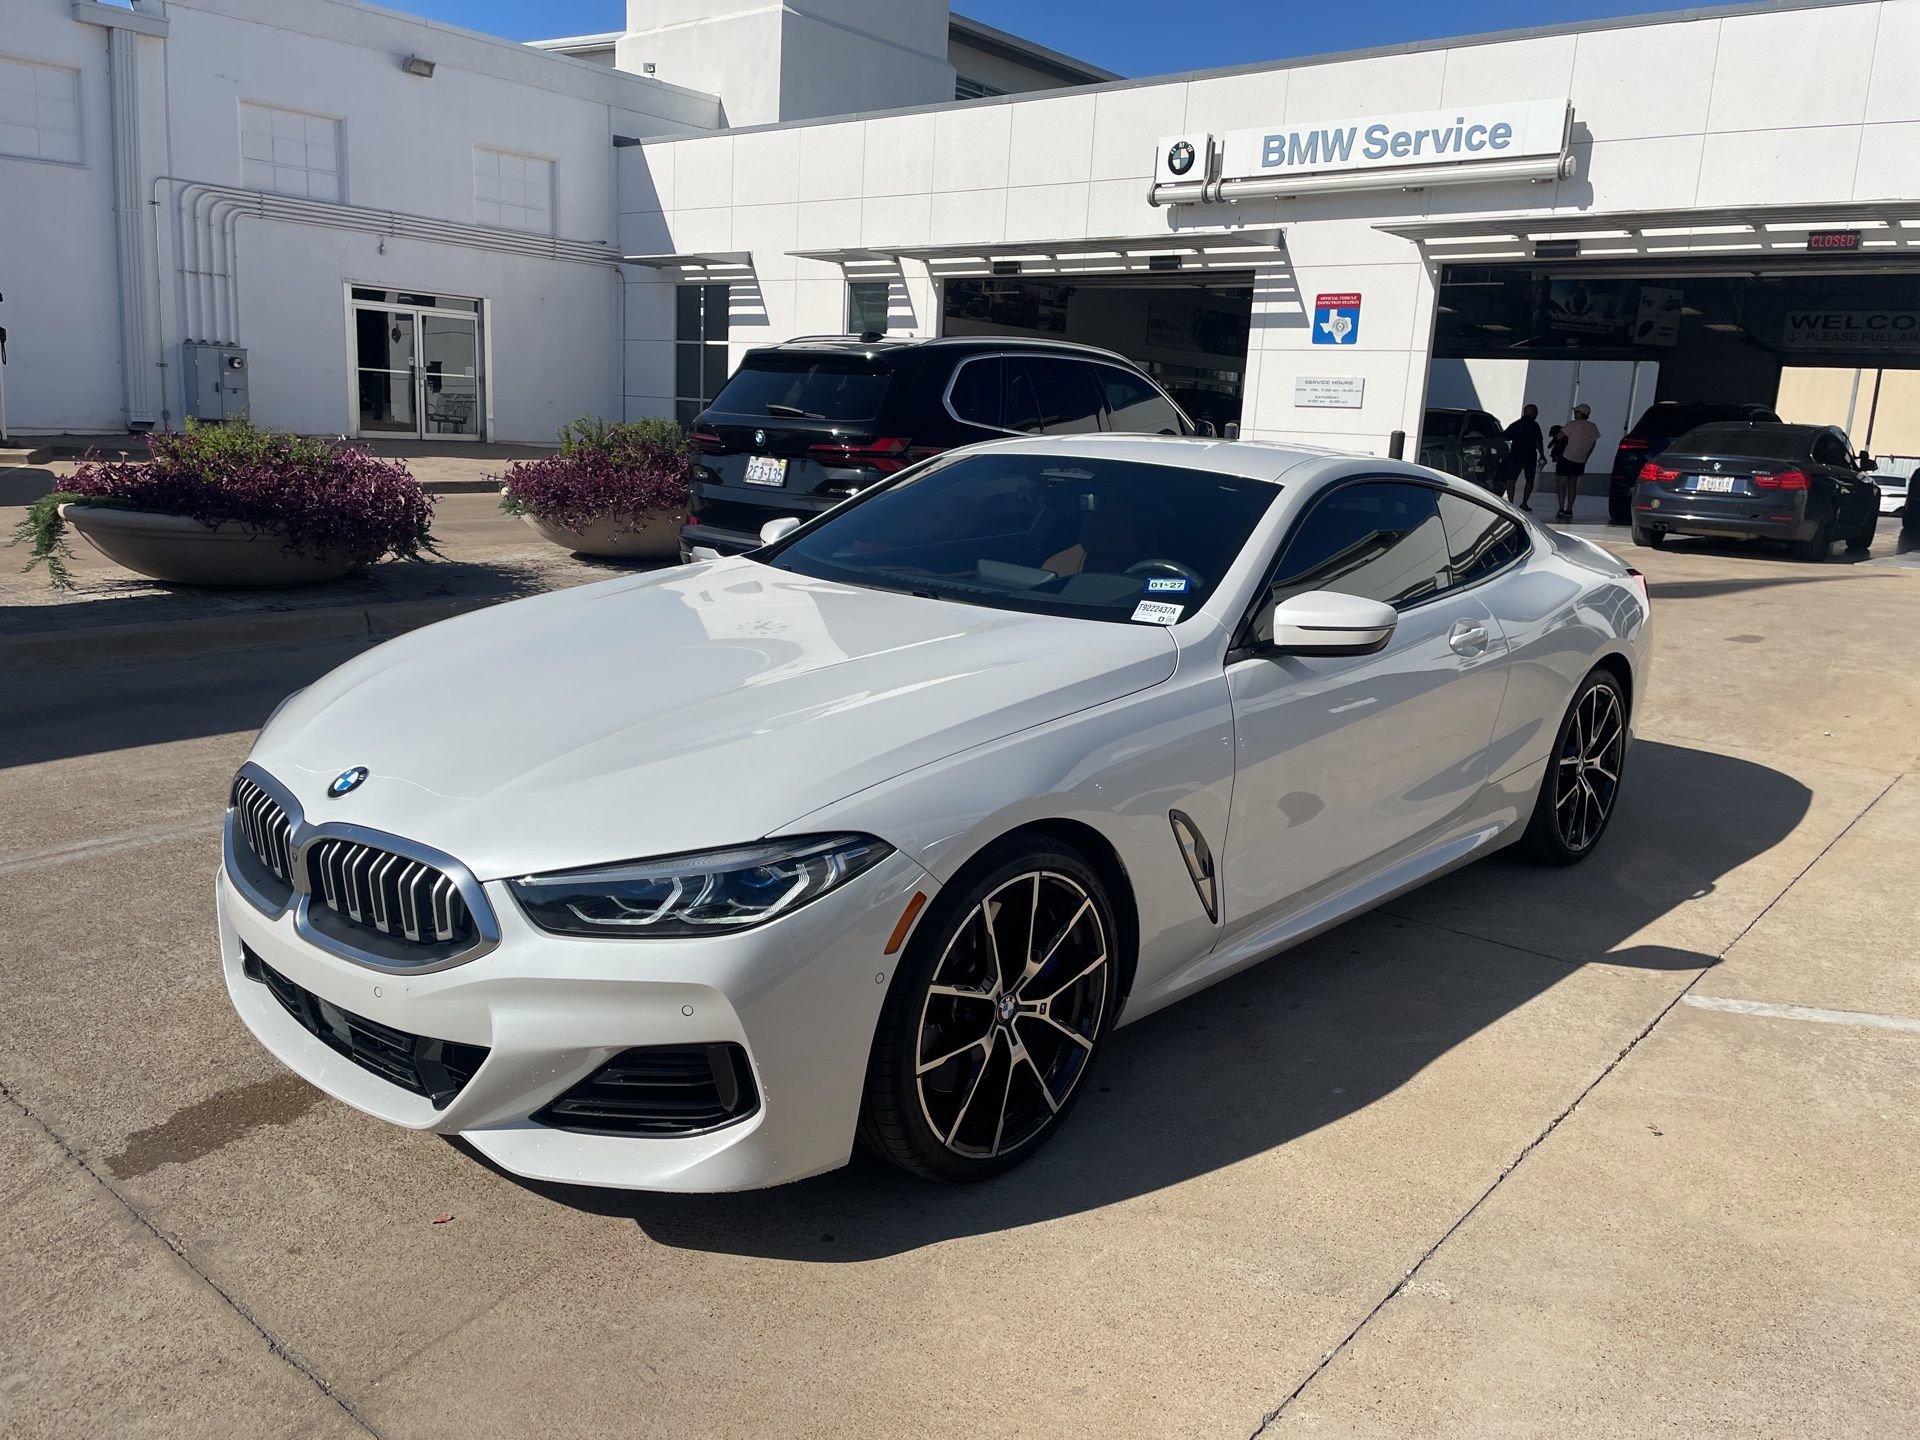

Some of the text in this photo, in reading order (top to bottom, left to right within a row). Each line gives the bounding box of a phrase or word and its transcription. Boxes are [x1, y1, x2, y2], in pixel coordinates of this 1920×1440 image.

[1261, 116, 1513, 168] BMW Service
[1811, 234, 1855, 248] CLOSED
[1790, 314, 1920, 330] WELCO
[1806, 332, 1857, 342] PLEASE
[1861, 332, 1895, 342] PULL
